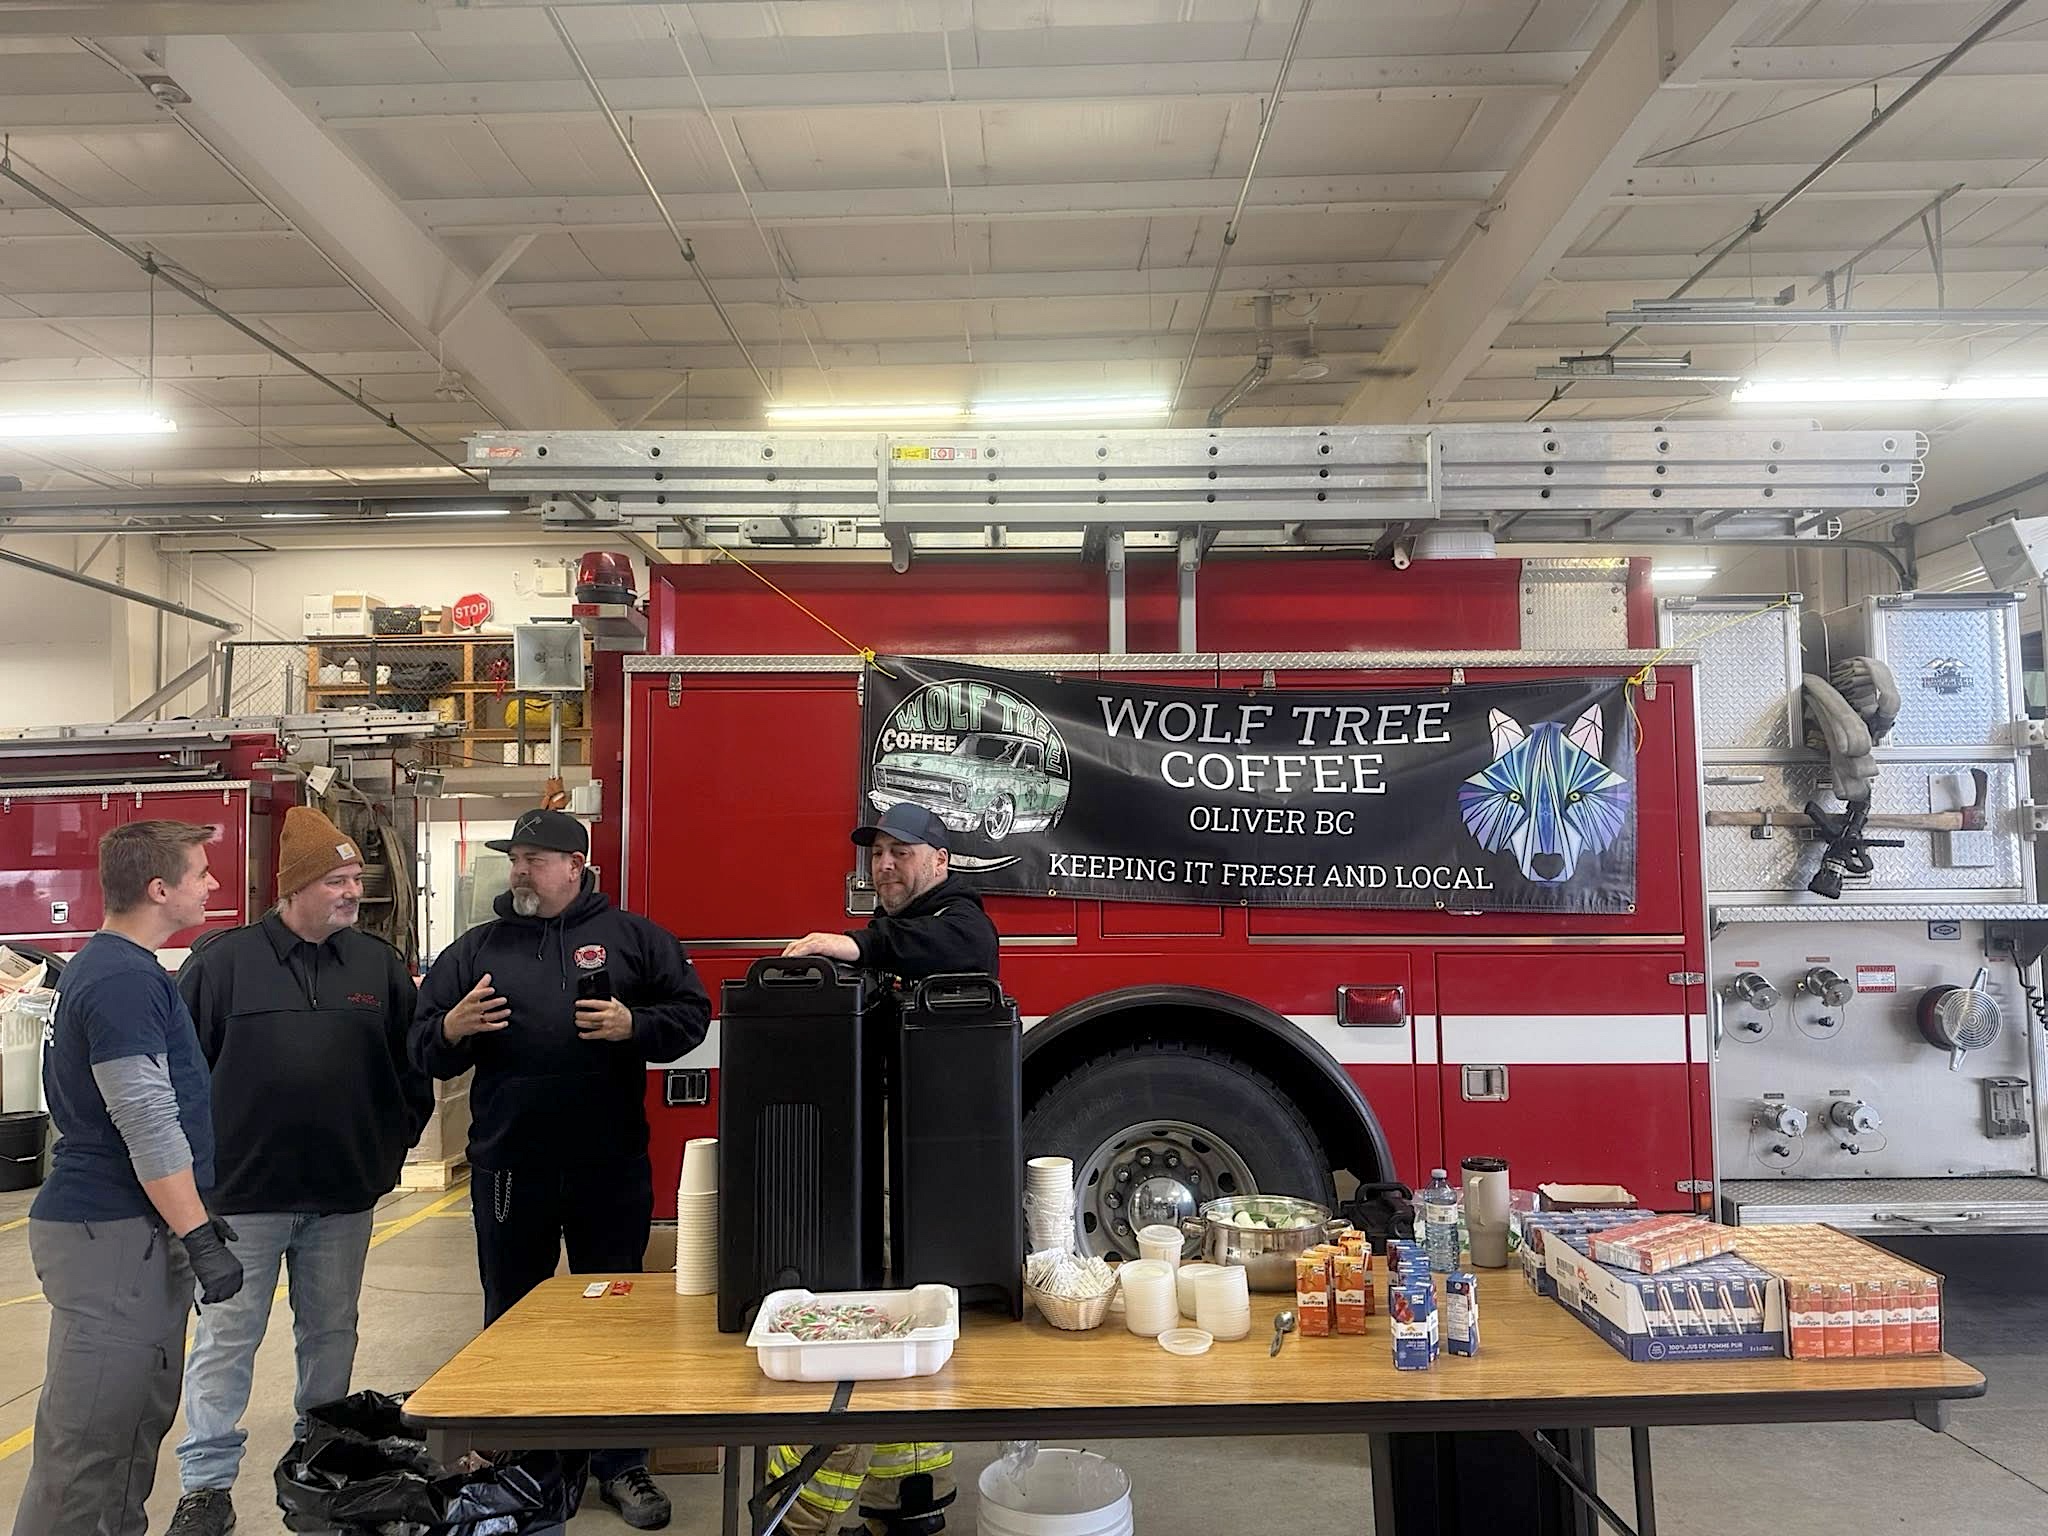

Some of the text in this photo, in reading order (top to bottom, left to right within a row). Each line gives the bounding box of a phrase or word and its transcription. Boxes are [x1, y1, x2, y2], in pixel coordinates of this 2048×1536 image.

[455, 602, 487, 619] STOP
[895, 682, 1062, 775] WOLF TREE
[1097, 696, 1450, 746] WOLF TREE
[882, 728, 958, 753] COFFEE
[1160, 750, 1386, 794] COFFEE
[1189, 806, 1355, 835] OLIVER BC
[1048, 853, 1494, 890] KEEPING IT FRESH AND LOCAL
